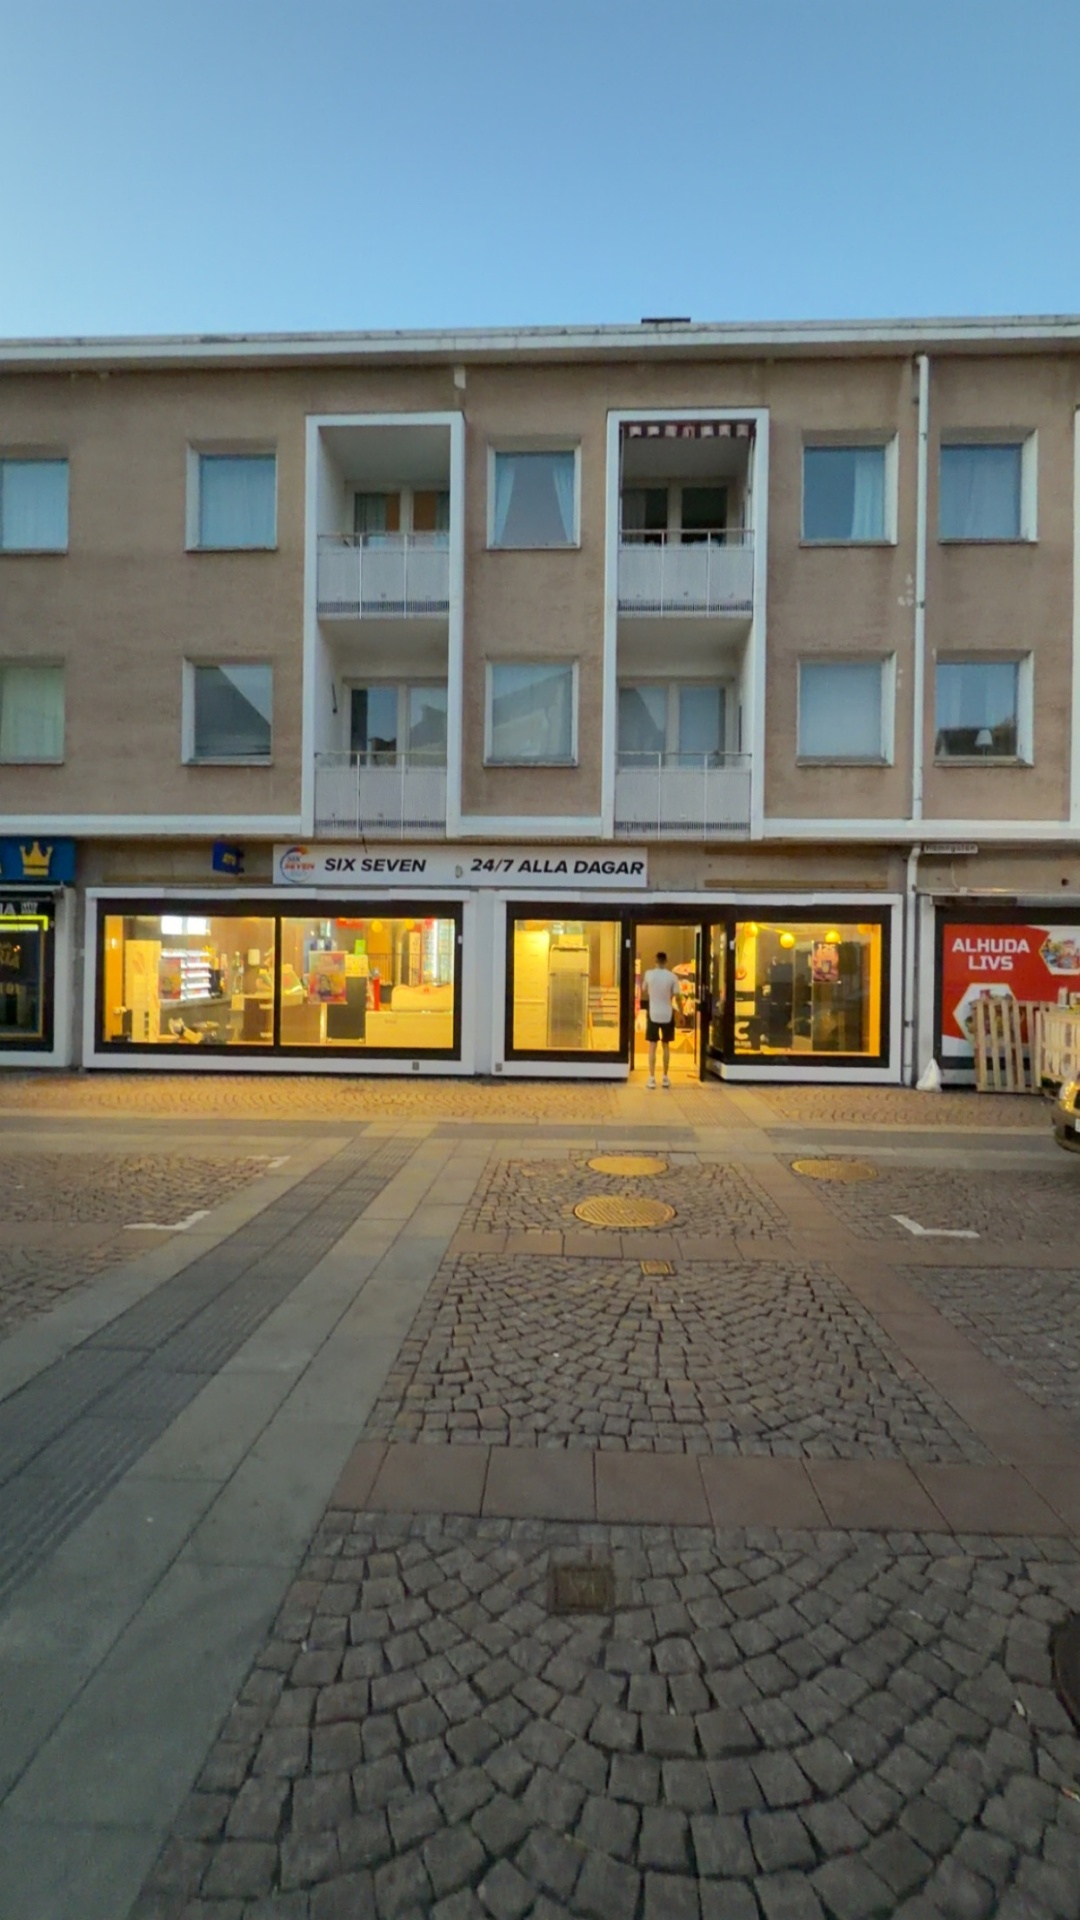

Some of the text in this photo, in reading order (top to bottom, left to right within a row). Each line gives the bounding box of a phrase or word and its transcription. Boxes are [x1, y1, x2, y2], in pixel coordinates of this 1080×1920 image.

[324, 858, 426, 872] SIX SEVEN
[470, 858, 645, 875] 24/7 ALLA DAGAR
[952, 938, 1030, 953] ALHUDA
[968, 955, 1014, 971] LIVS
